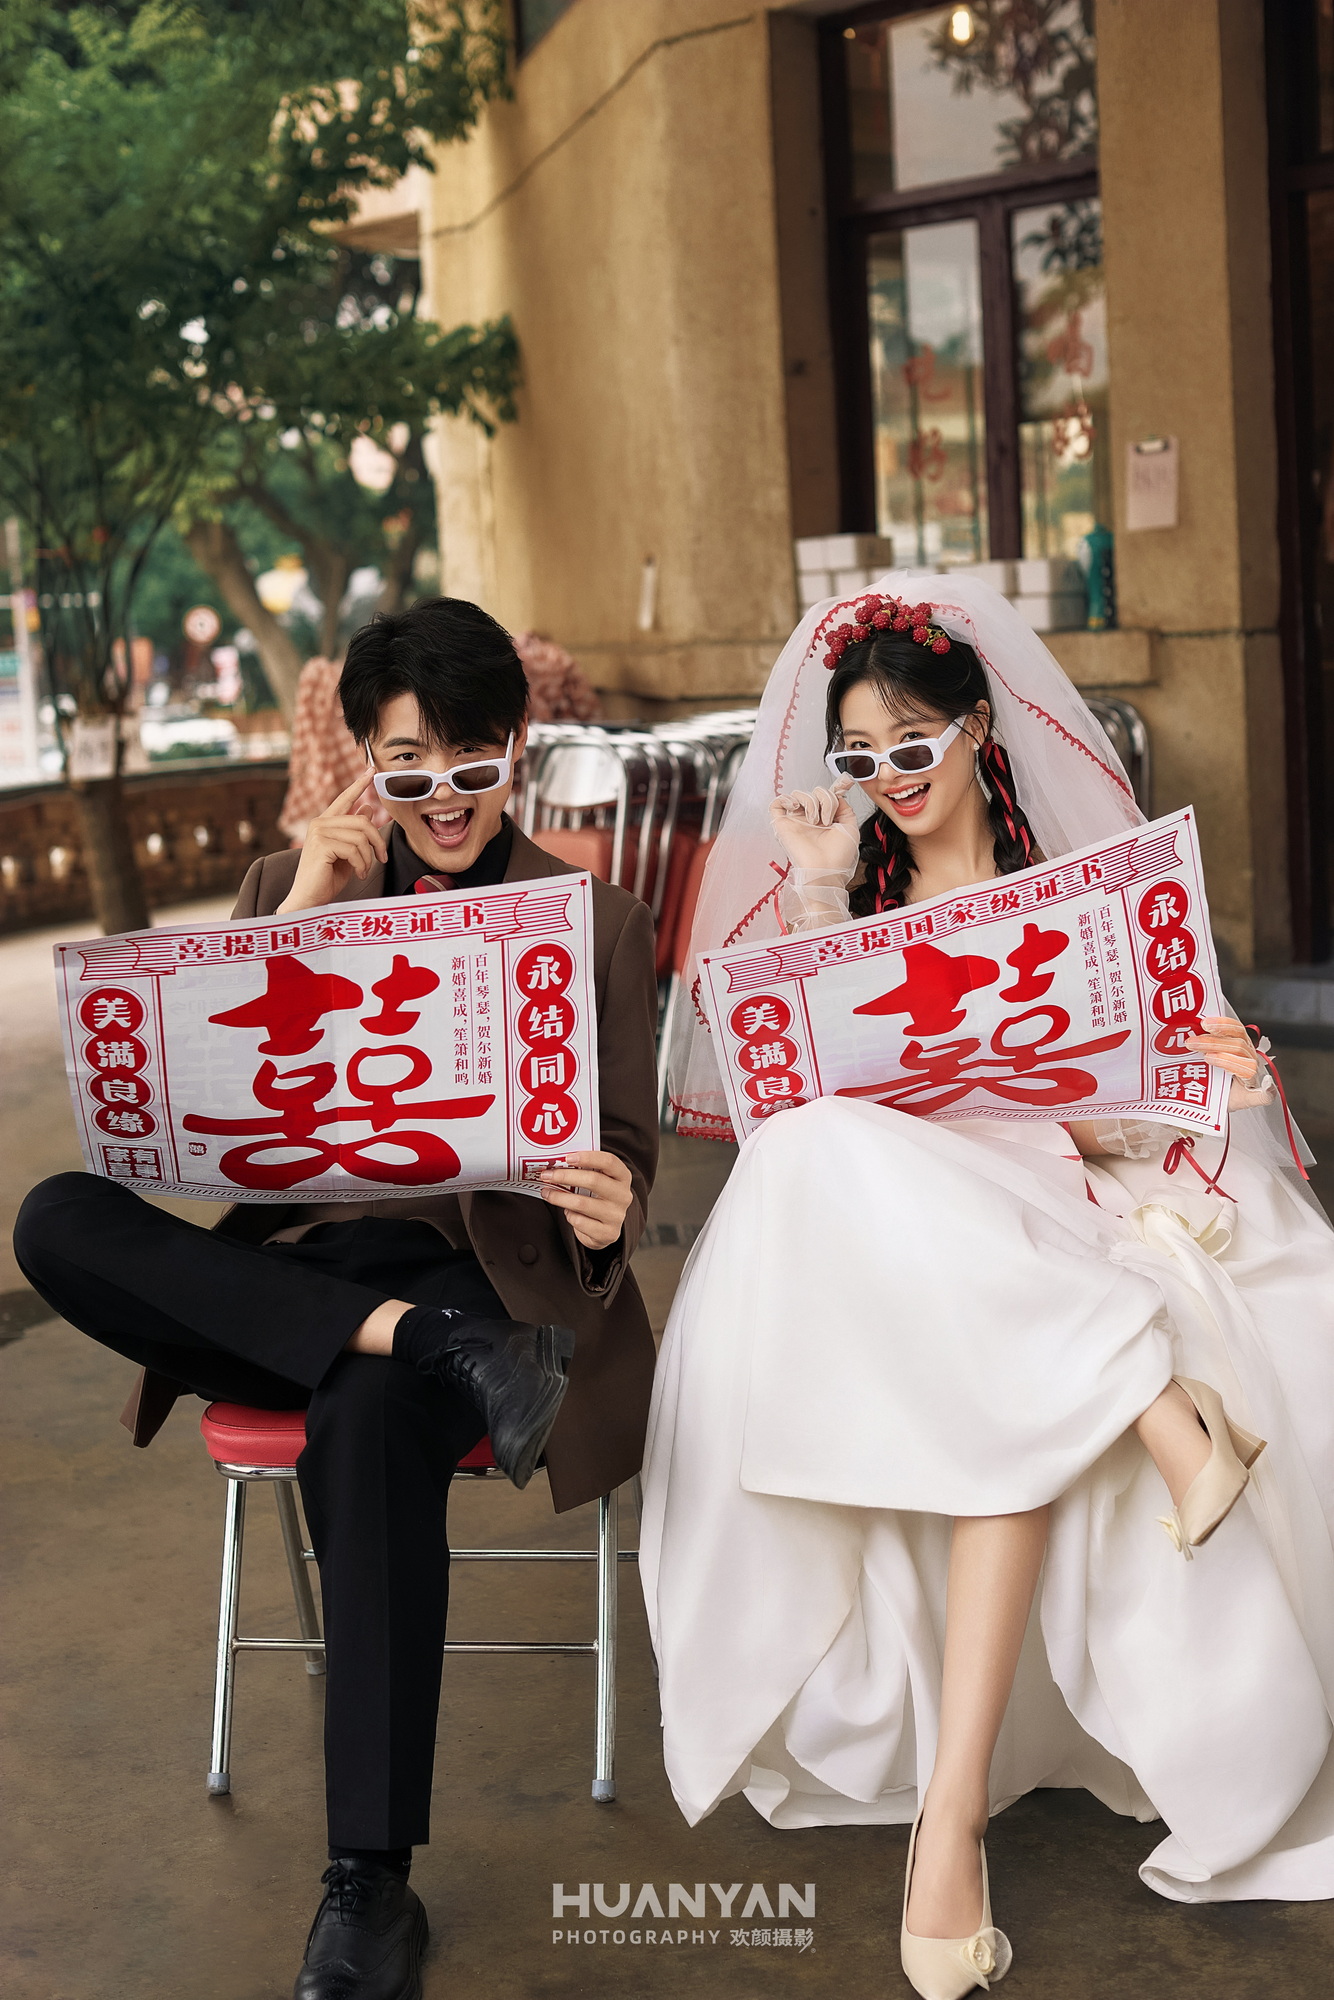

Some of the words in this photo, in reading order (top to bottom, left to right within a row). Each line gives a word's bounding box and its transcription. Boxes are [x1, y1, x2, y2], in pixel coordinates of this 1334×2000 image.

[174, 903, 488, 961] 喜提国家级证书
[812, 857, 1104, 962] 喜提国家级证书
[1147, 892, 1197, 1048] 永结同心
[92, 997, 146, 1133] 美满良缘
[527, 956, 569, 1135] 永结同心
[1157, 1064, 1207, 1085] 百年
[1157, 1080, 1207, 1103] 好合
